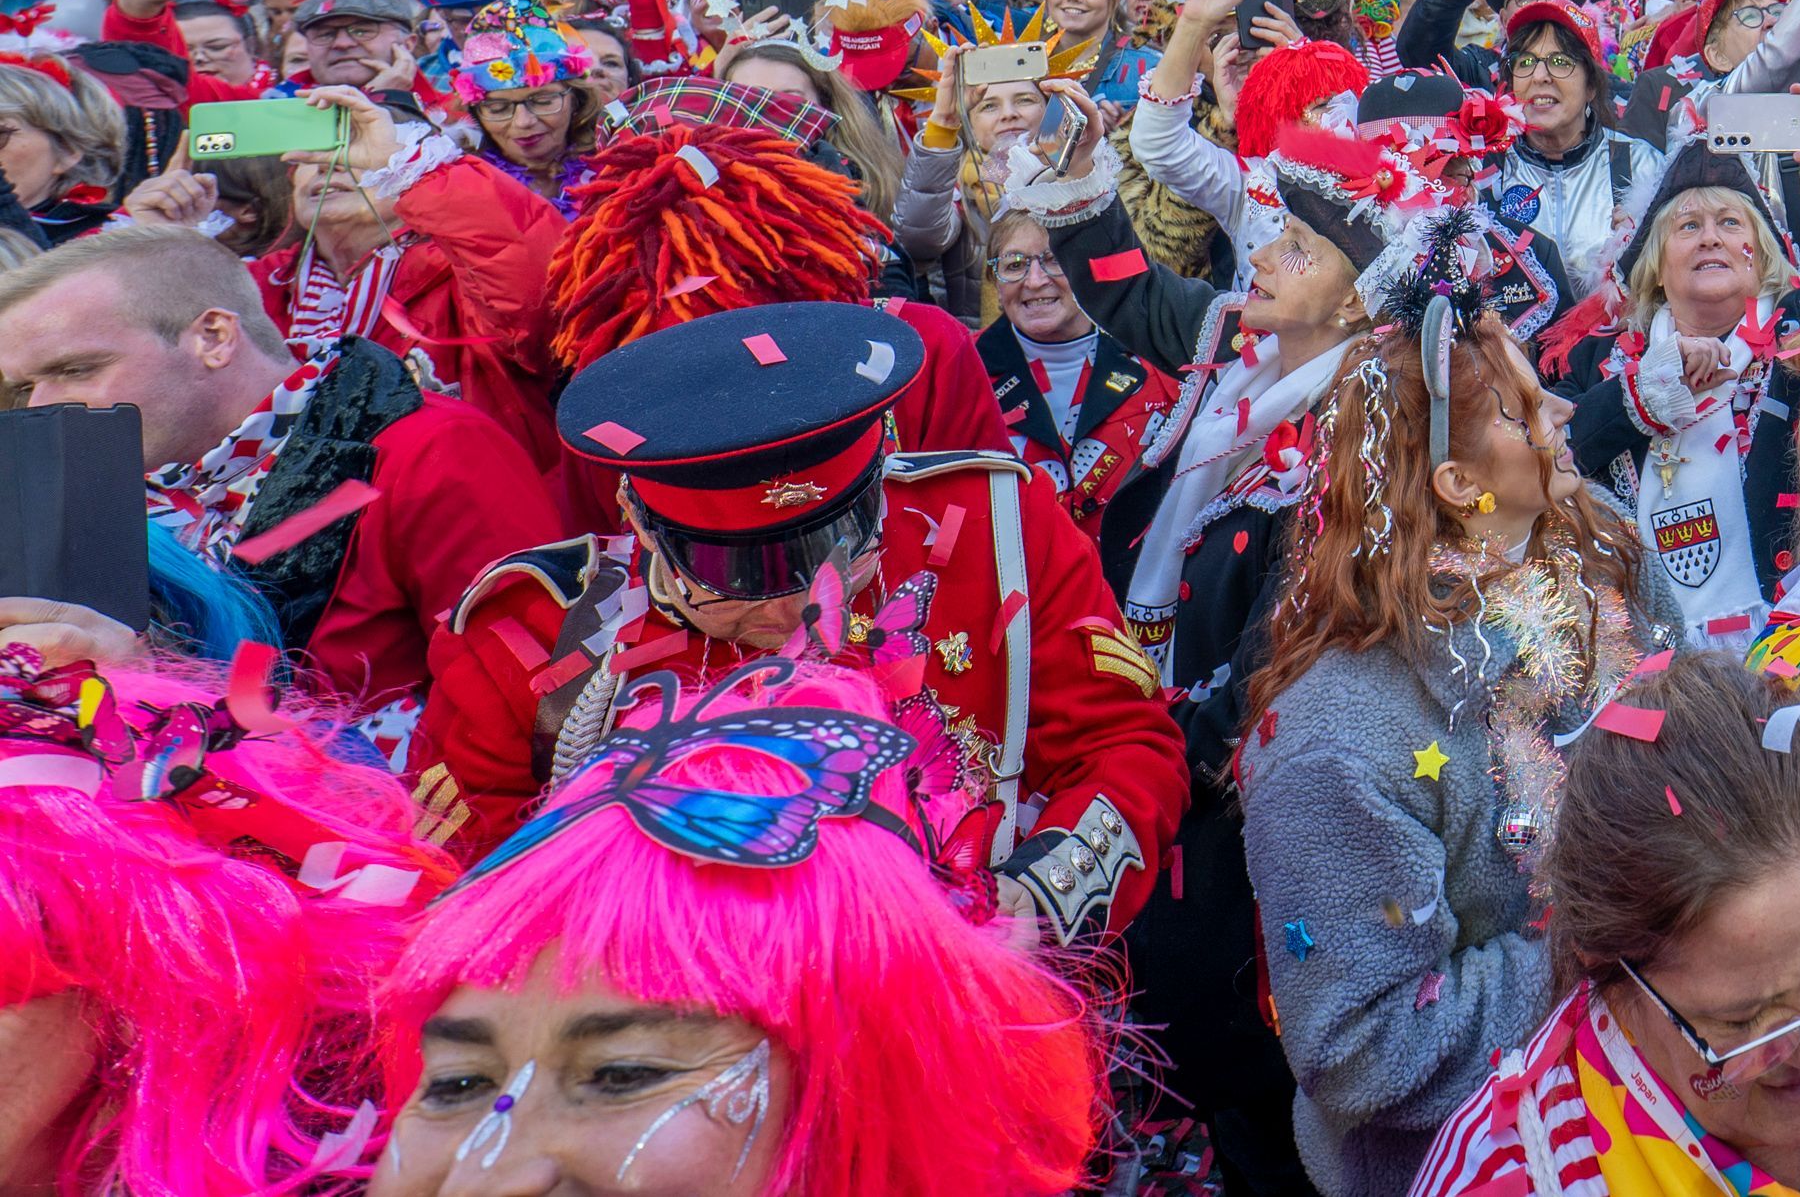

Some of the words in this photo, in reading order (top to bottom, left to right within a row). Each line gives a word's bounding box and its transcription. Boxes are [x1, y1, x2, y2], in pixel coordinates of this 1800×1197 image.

[1500, 199, 1538, 213] SPACE
[1658, 505, 1706, 526] KÖLN
[1631, 1072, 1657, 1106] Japan
